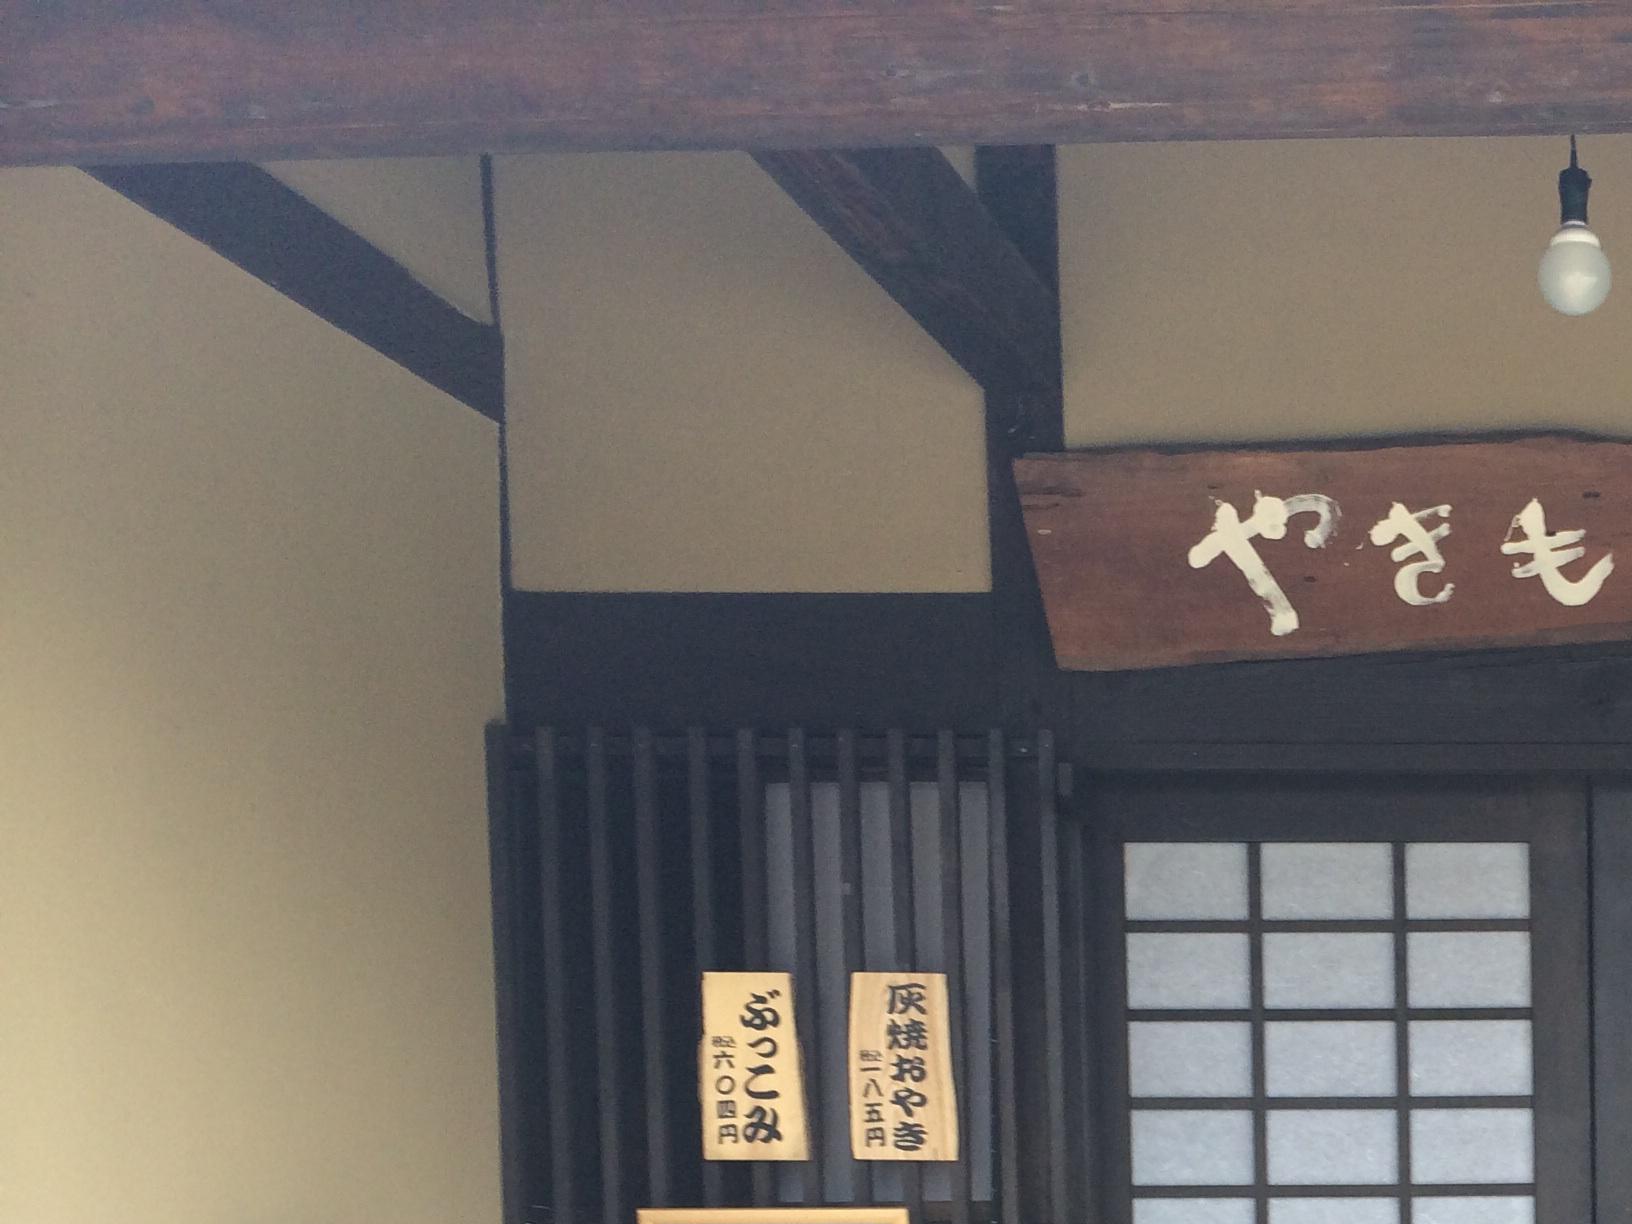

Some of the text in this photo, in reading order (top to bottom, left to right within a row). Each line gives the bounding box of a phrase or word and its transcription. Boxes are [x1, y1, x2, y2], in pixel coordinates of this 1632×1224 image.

[740, 989, 783, 1145] ぶっこみ
[886, 982, 929, 1152] 灰焼おやき
